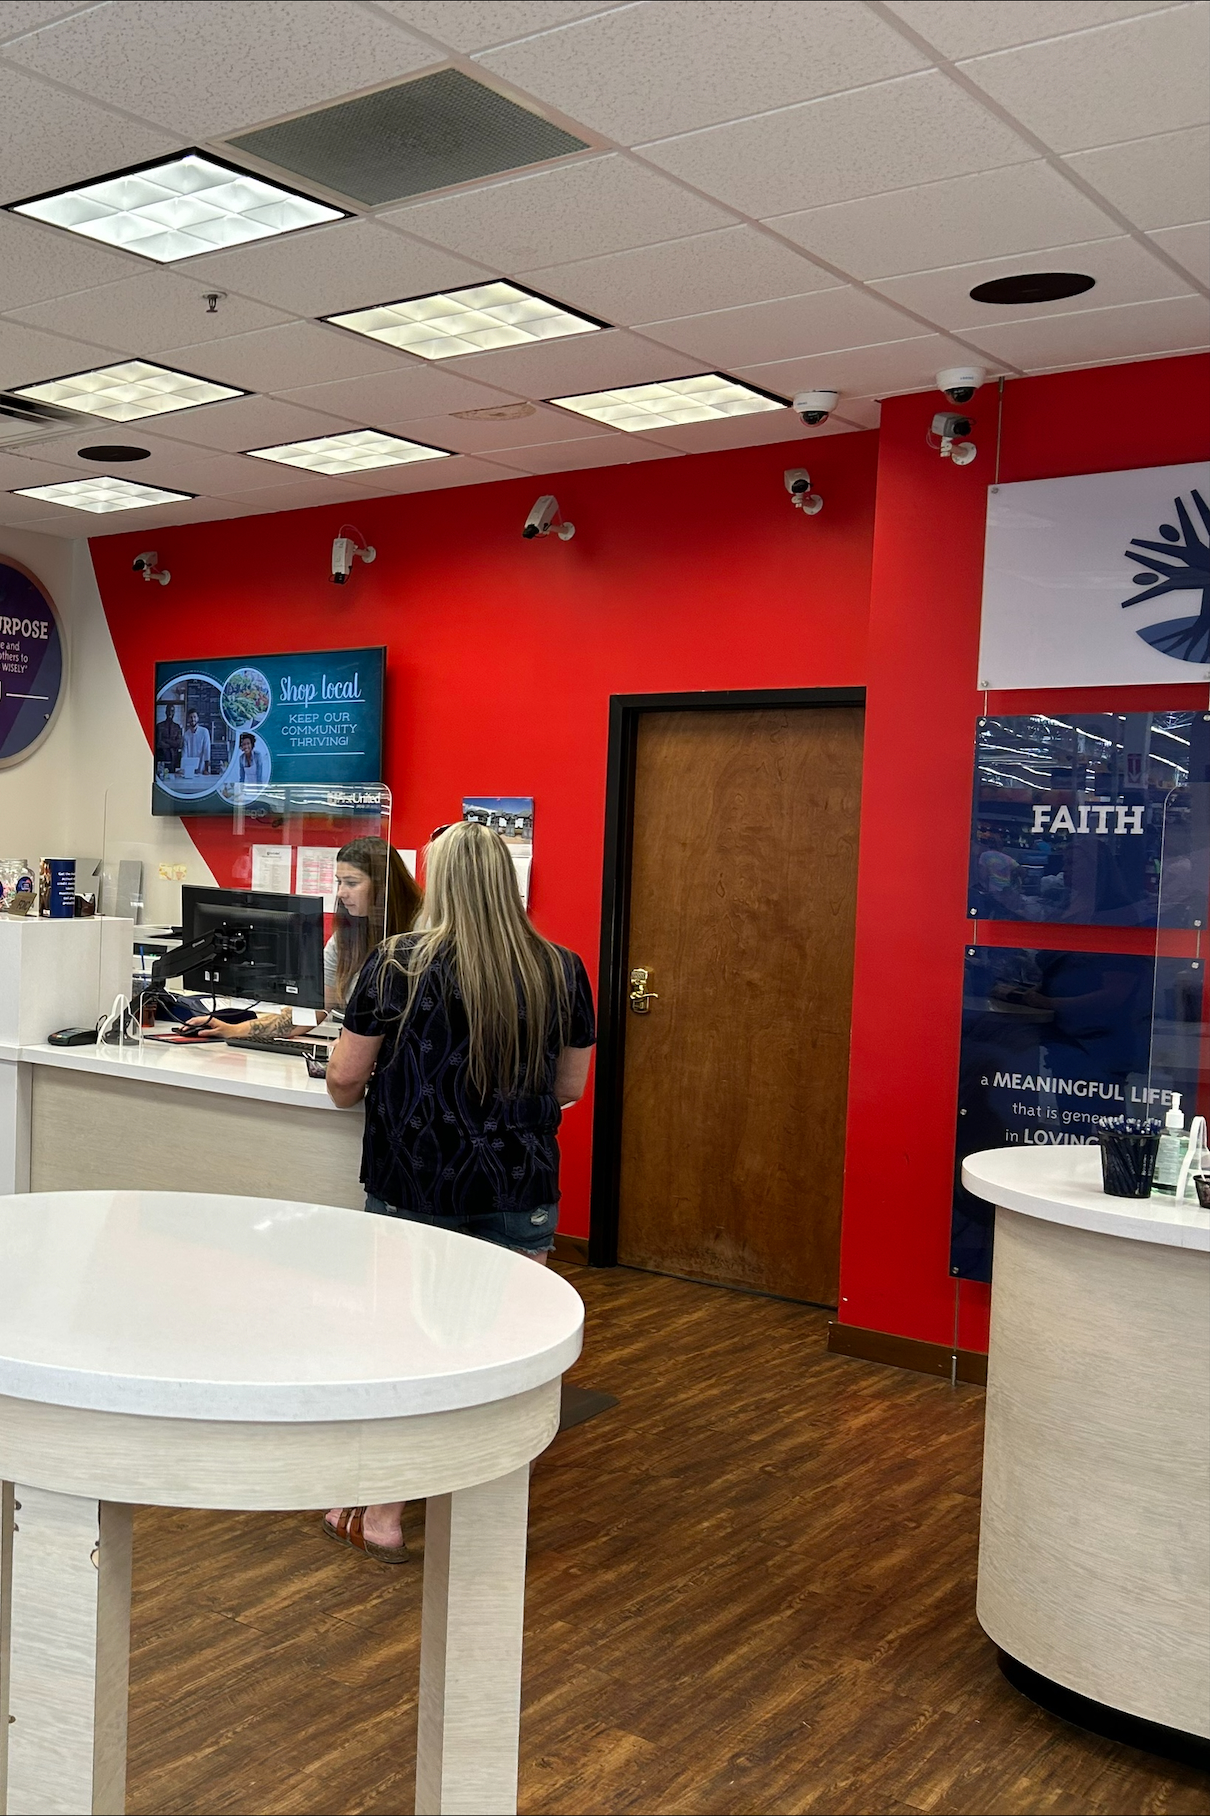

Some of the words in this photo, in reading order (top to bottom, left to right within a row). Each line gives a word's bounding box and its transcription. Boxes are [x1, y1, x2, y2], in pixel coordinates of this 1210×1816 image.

[6, 641, 20, 652] and
[20, 653, 29, 663] to
[280, 676, 318, 708] Shop
[321, 672, 362, 700] local
[289, 714, 320, 724] KEEP
[324, 712, 350, 723] OUR
[281, 723, 357, 736] COMMUNITY
[290, 736, 349, 747] THRIVING!
[1031, 805, 1145, 835] FAITH
[980, 1075, 989, 1086] a
[993, 1071, 1125, 1102] MEANINGFUL
[1130, 1086, 1172, 1106] LIFE
[1012, 1102, 1041, 1118] that
[1046, 1106, 1057, 1119] is
[1005, 1129, 1019, 1143] in
